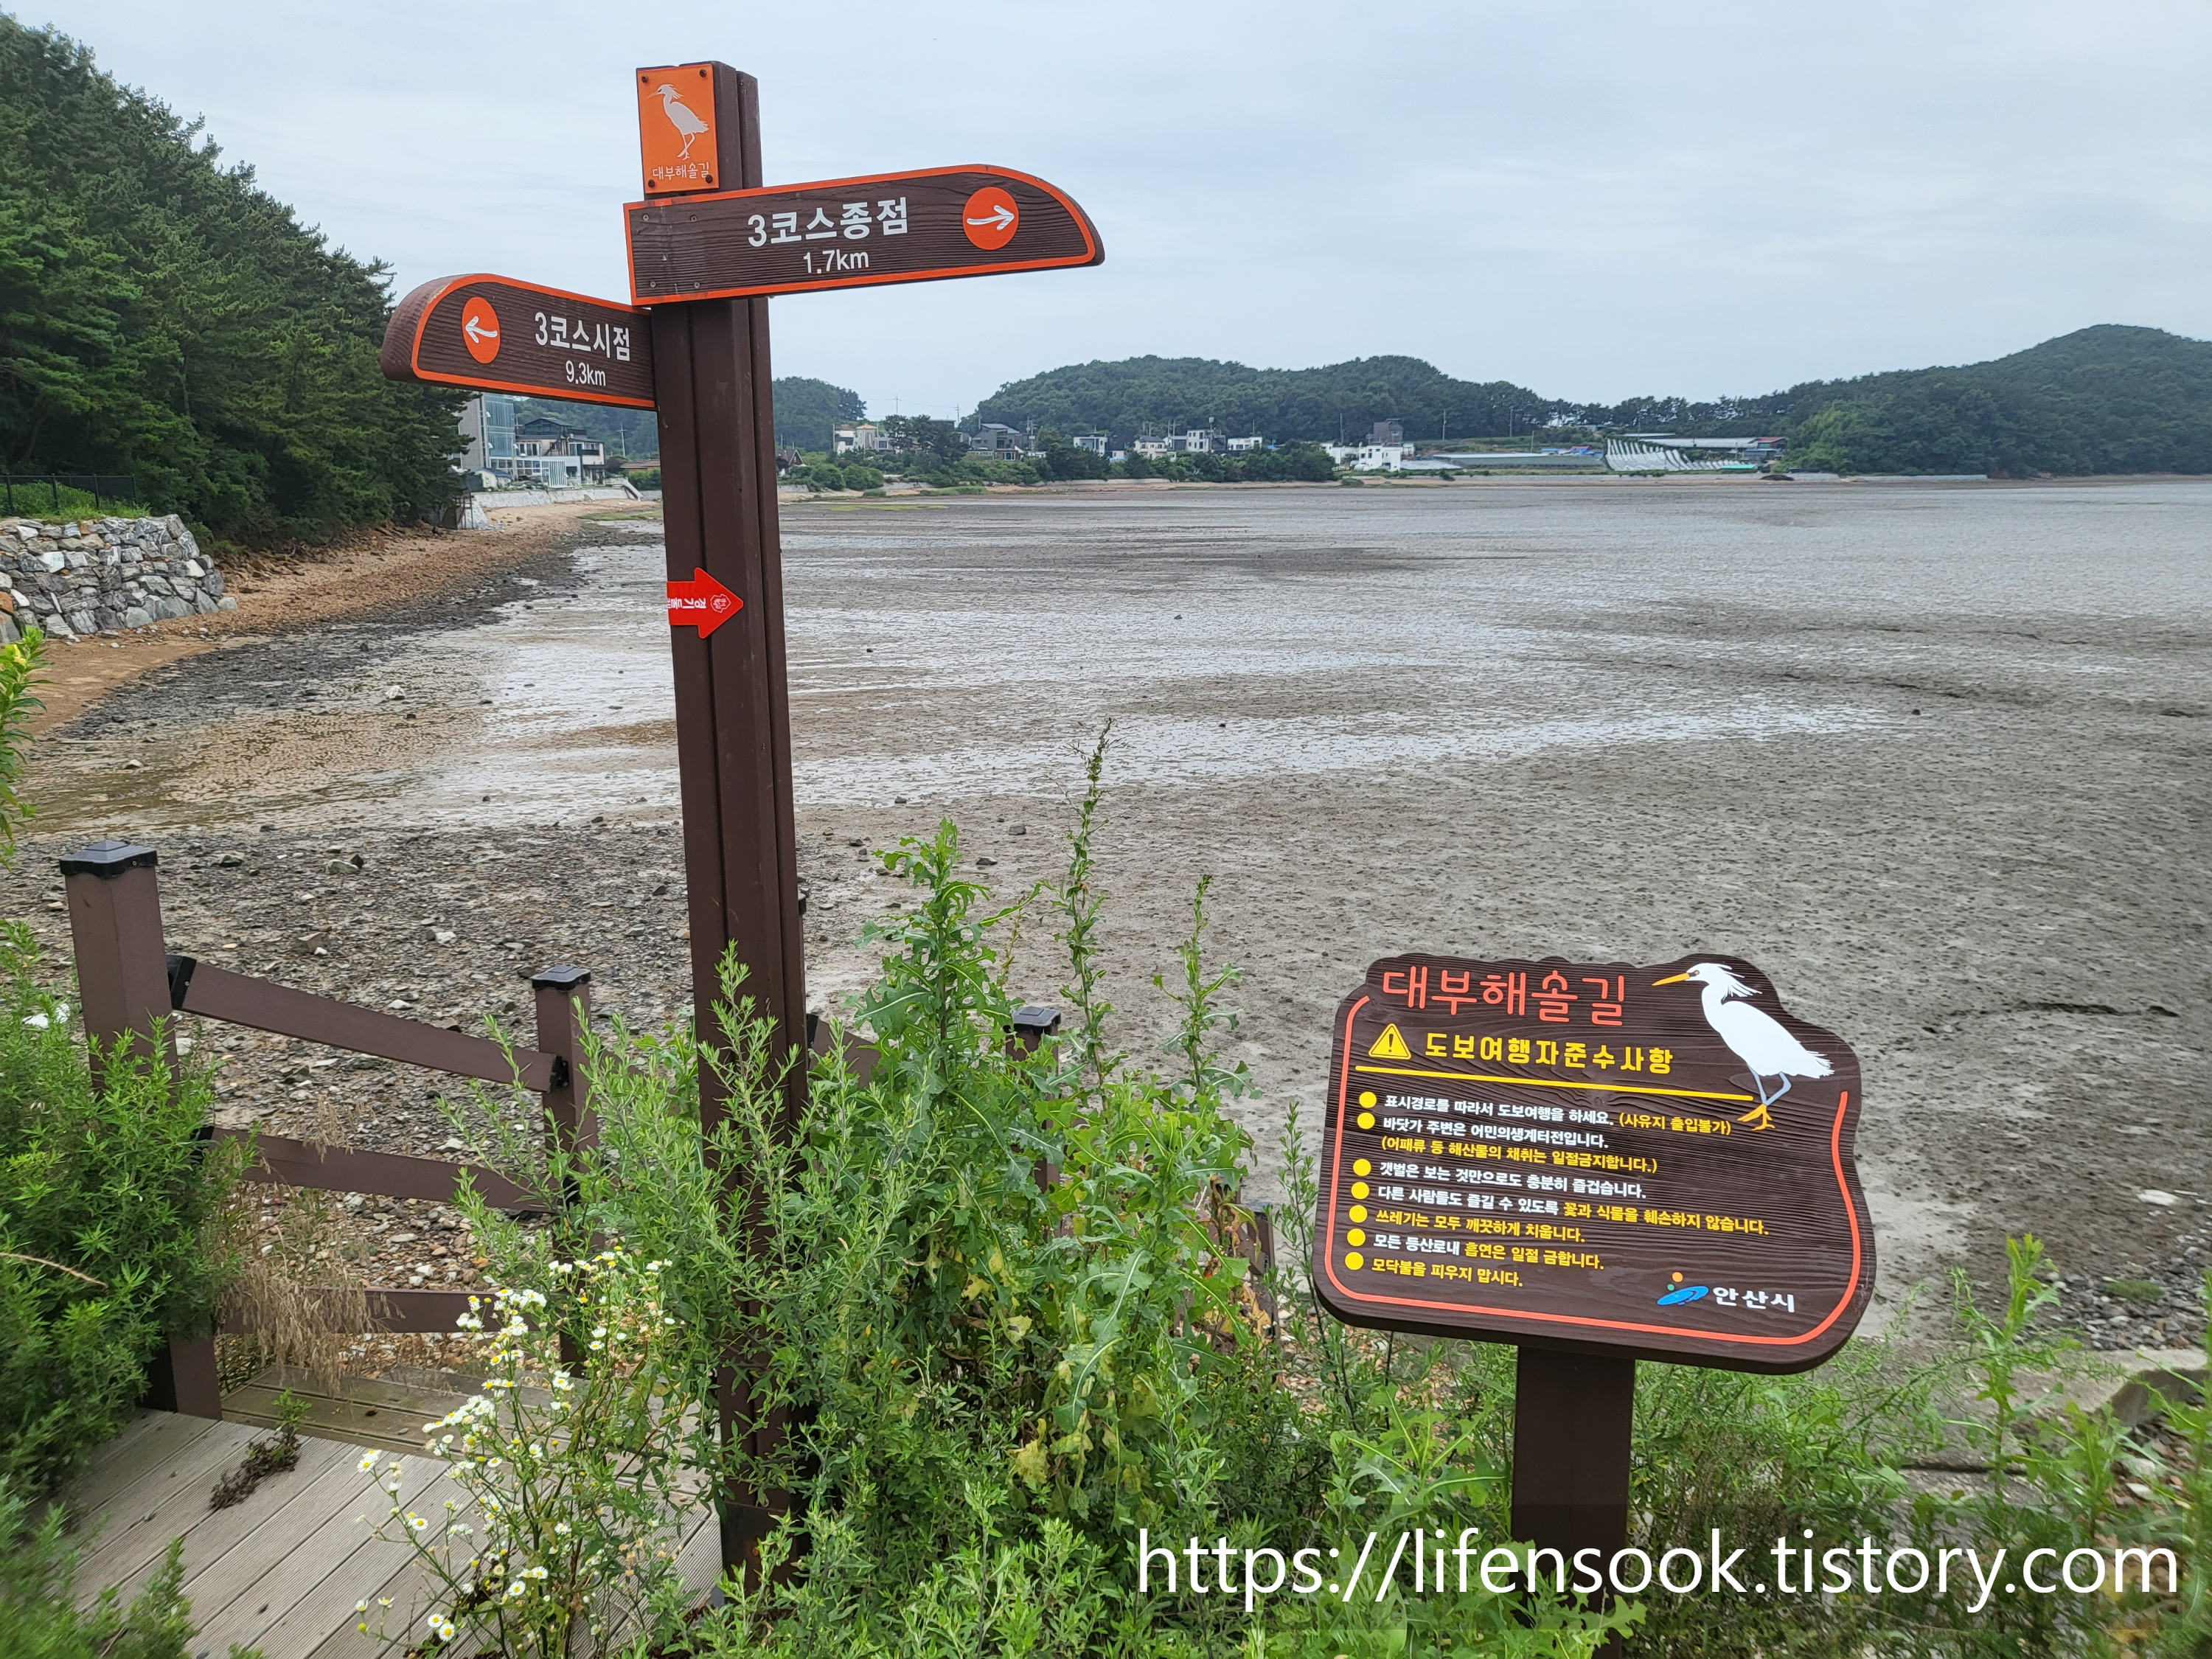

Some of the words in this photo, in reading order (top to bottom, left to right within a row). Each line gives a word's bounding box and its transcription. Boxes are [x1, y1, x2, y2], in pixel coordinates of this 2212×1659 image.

[653, 161, 709, 181] 대부해솔길
[748, 197, 908, 247] 3코스종점
[804, 249, 869, 274] 1.7km
[535, 312, 630, 361] 3코스시점
[566, 360, 606, 386] 9.3km
[1382, 966, 1625, 1026] 대부해솔길
[1425, 1032, 1674, 1074] 도보여행자준수사항
[1383, 1117, 1422, 1133] 바닷가
[1426, 1120, 1466, 1136] 주변은
[1470, 1124, 1609, 1149] 어민의생계터전입니다.
[1384, 1095, 1450, 1111] 표시경로를
[1454, 1100, 1493, 1116] 따라서
[1498, 1105, 1564, 1121] 도보여행을
[1568, 1109, 1614, 1126] 하세요.
[1618, 1112, 1666, 1130] (사유지
[1670, 1118, 1731, 1135] 출입불가)
[1381, 1135, 1426, 1152] (어패류
[1430, 1140, 1444, 1155] 등
[1448, 1143, 1501, 1159] 해산물의
[1506, 1147, 1546, 1164] 채취는
[1551, 1151, 1658, 1174] 일절금지합니다.)
[1380, 1162, 1419, 1178] 갯벌은
[1425, 1166, 1450, 1181] 보는
[1455, 1168, 1523, 1187] 것만으로도
[1526, 1174, 1568, 1192] 충분히
[1572, 1179, 1646, 1199] 즐겁습니다.
[1375, 1209, 1430, 1228] 쓰레기는
[1434, 1215, 1461, 1231] 모두
[1465, 1218, 1520, 1237] 깨끗하게
[1526, 1223, 1585, 1243] 치웁니다.
[1378, 1186, 1404, 1201] 다른
[1408, 1189, 1463, 1206] 사람들도
[1467, 1194, 1494, 1210] 즐길
[1498, 1196, 1513, 1211] 수
[1518, 1198, 1559, 1215] 있도록
[1563, 1201, 1591, 1218] 꽃과
[1596, 1205, 1638, 1223] 식물을
[1644, 1210, 1700, 1228] 훼손하지
[1705, 1214, 1770, 1235] 않습니다.
[1373, 1234, 1402, 1250] 모든
[1405, 1237, 1460, 1256] 등산로내
[1464, 1242, 1506, 1260] 흡연은
[1511, 1246, 1539, 1264] 일절
[1543, 1249, 1604, 1270] 금합니다.
[1371, 1258, 1426, 1277] 모닥불을
[1430, 1264, 1472, 1282] 피우지
[1476, 1269, 1523, 1287] 맙시다.
[1712, 1287, 1795, 1312] 안산시
